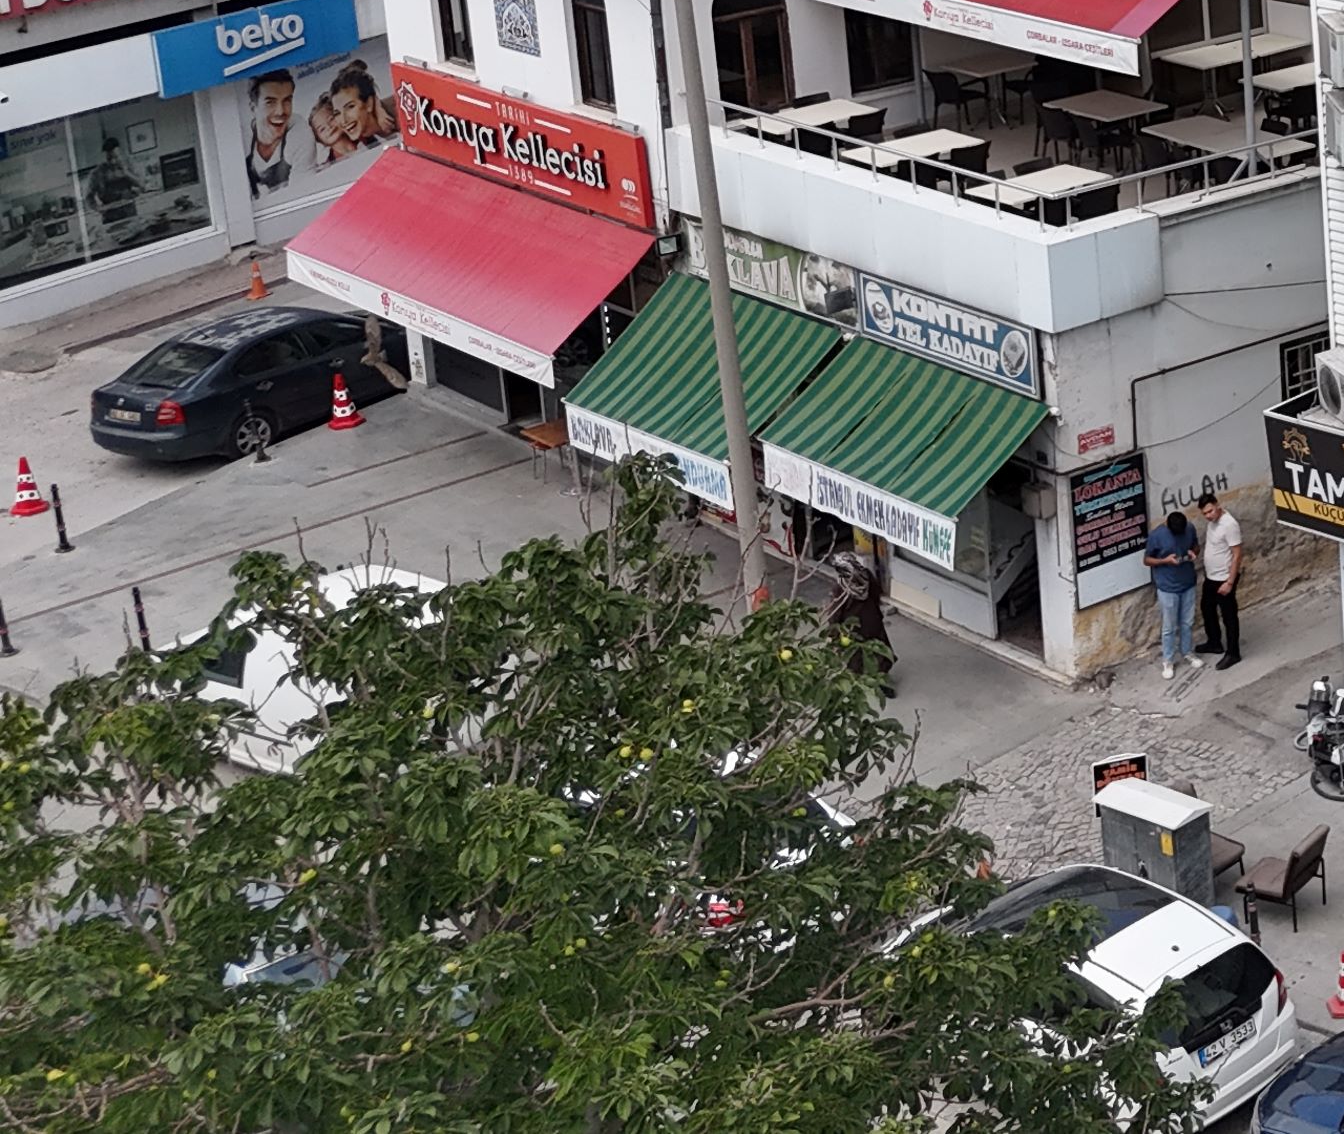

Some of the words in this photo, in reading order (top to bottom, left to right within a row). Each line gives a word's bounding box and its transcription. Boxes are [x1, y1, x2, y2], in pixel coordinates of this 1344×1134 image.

[215, 14, 304, 56] beko
[416, 99, 496, 165] Konya
[500, 123, 606, 189] Kellecisi
[508, 165, 534, 184] 1389
[895, 318, 927, 347] TEL
[928, 328, 1000, 372] KADAYIF
[1161, 472, 1229, 516] ALLAH
